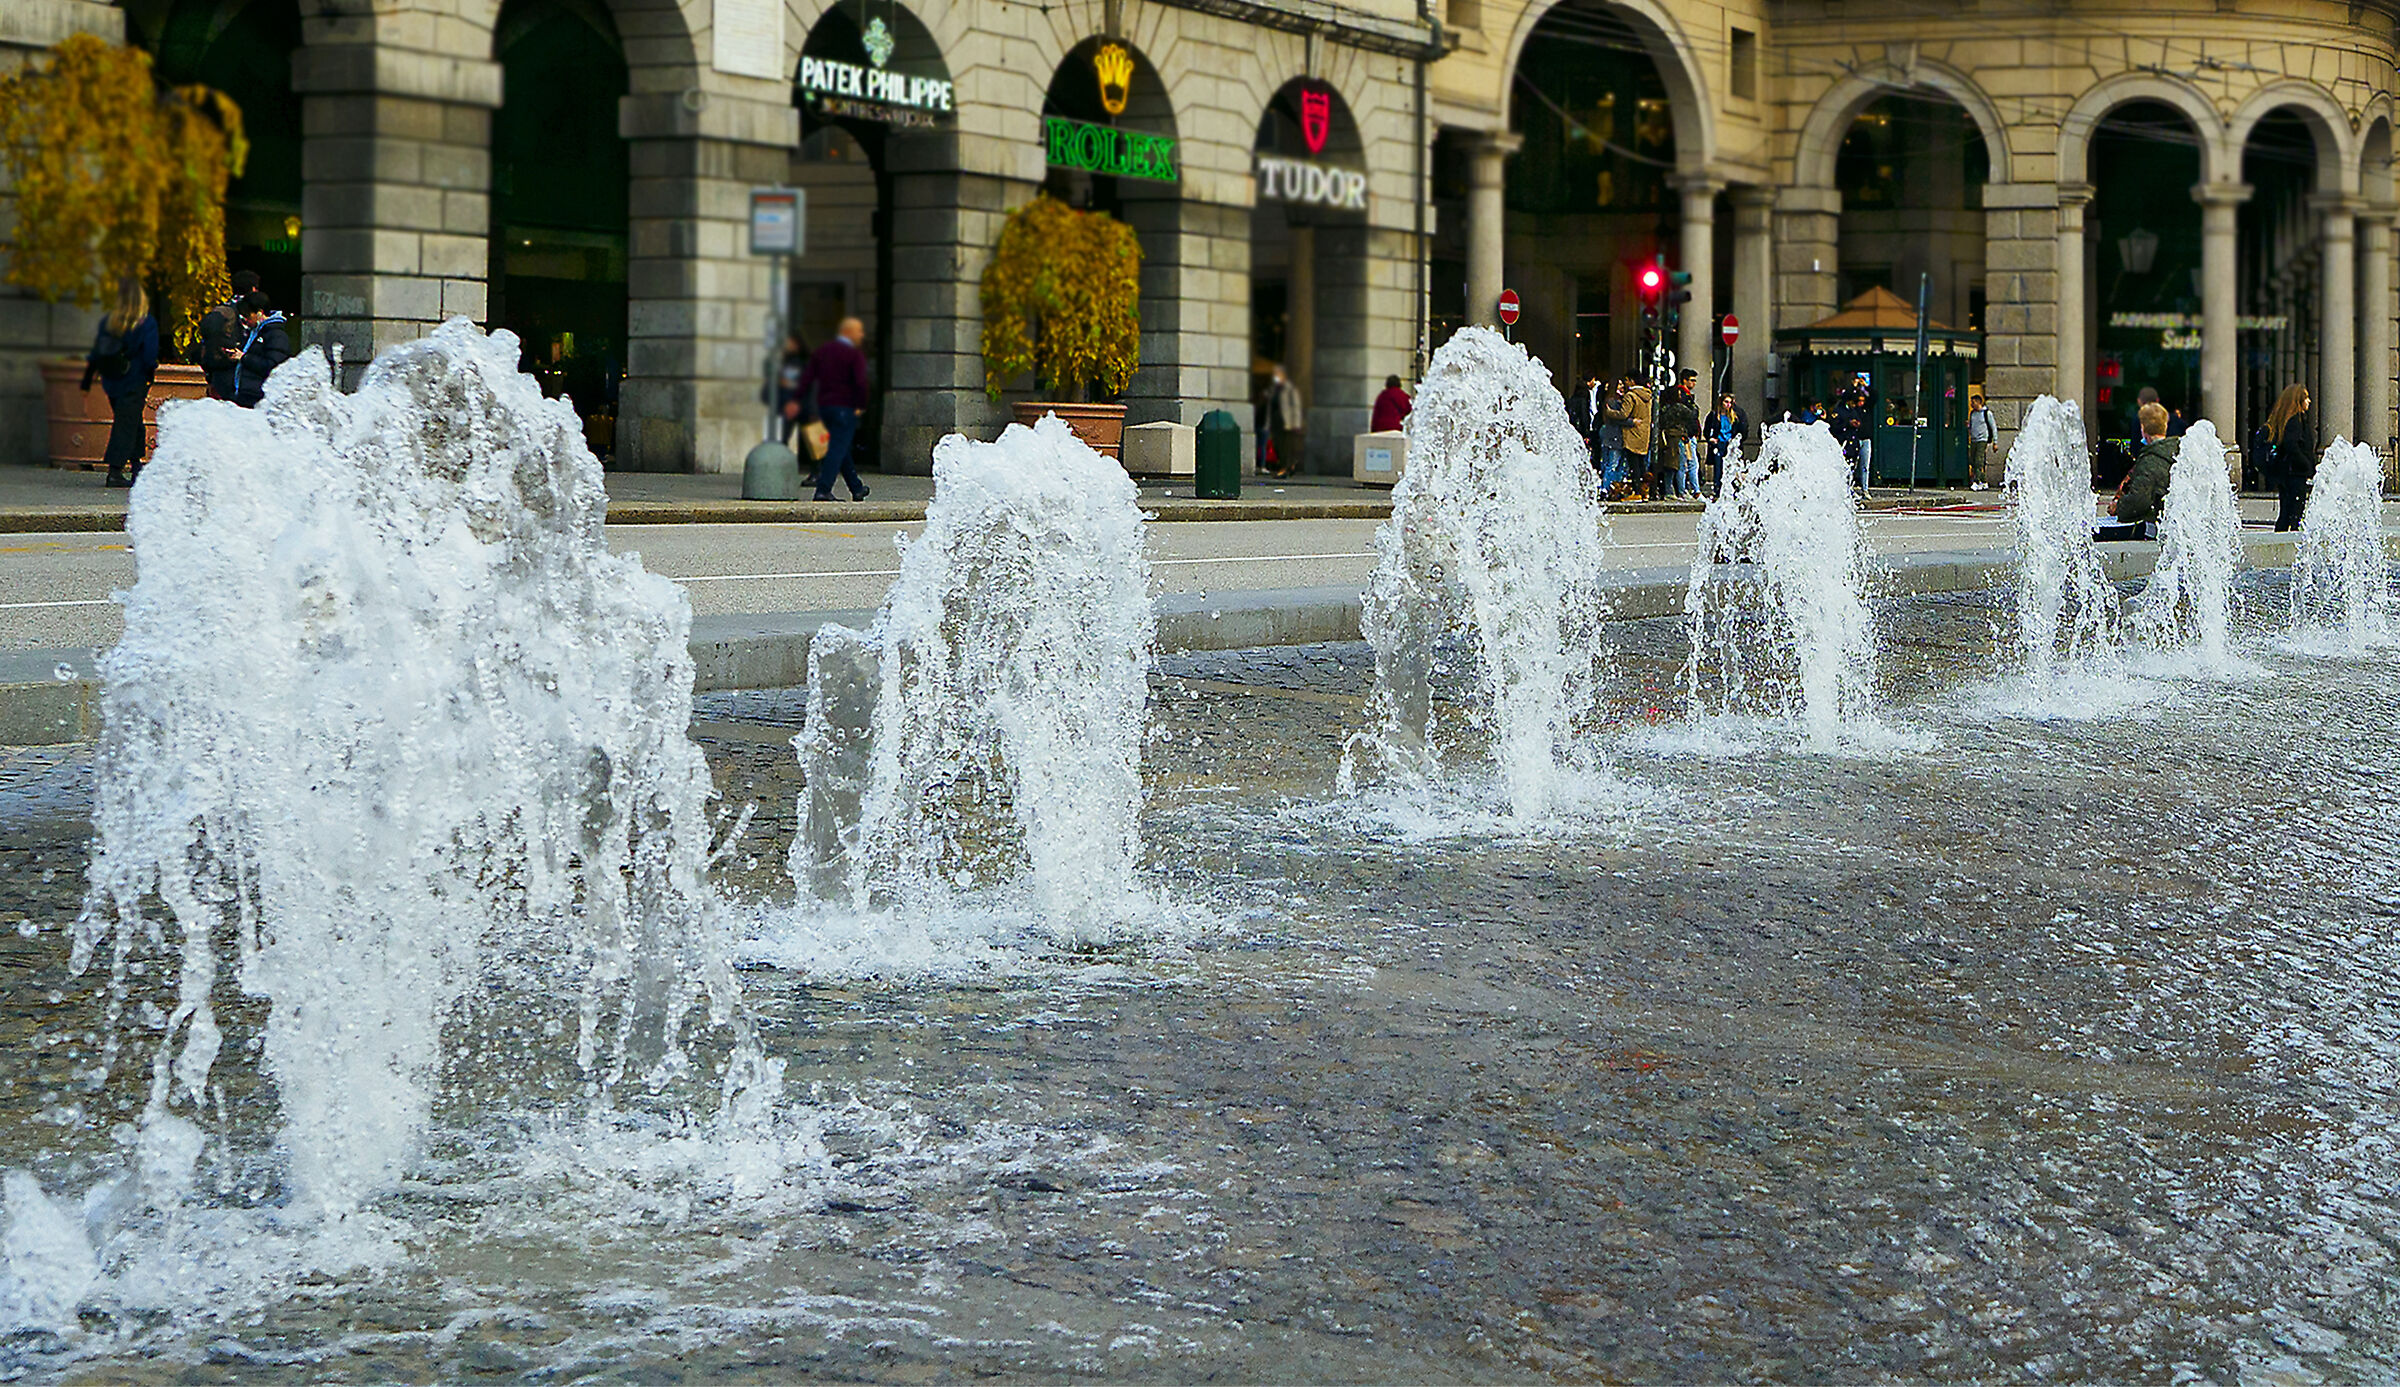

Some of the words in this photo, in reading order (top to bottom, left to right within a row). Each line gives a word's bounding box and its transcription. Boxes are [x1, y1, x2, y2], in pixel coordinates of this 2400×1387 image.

[801, 56, 863, 97] PATEK
[867, 67, 953, 111] PHILIPPE
[1046, 118, 1178, 182] ROLEX
[1259, 158, 1368, 209] TUDOR
[2161, 329, 2202, 350] Sush
